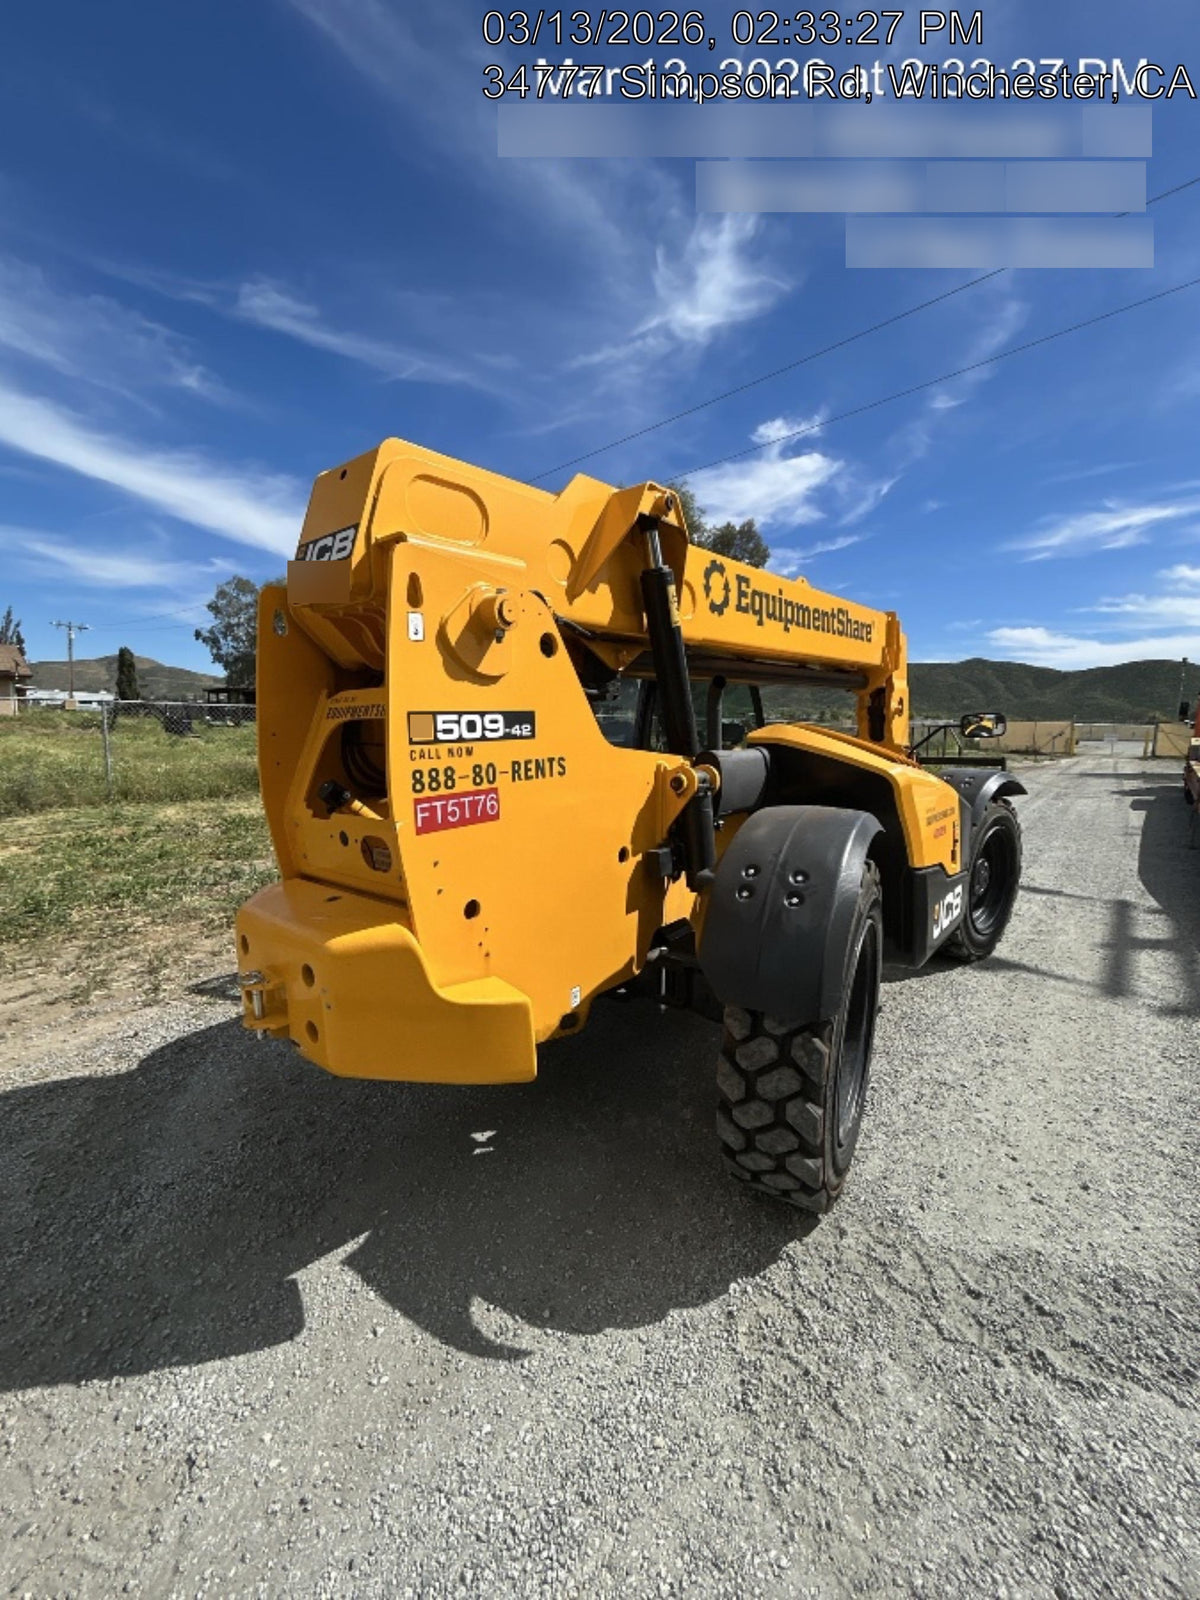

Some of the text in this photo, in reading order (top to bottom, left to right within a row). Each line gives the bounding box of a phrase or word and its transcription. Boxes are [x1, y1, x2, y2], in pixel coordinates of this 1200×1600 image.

[735, 573, 873, 643] EquipmentShare
[435, 713, 533, 741] 509-42
[410, 746, 474, 761] CALL NOW
[411, 756, 566, 794] 888-80-RENTS
[416, 793, 498, 828] FT5T76
[932, 884, 963, 940] JCB
